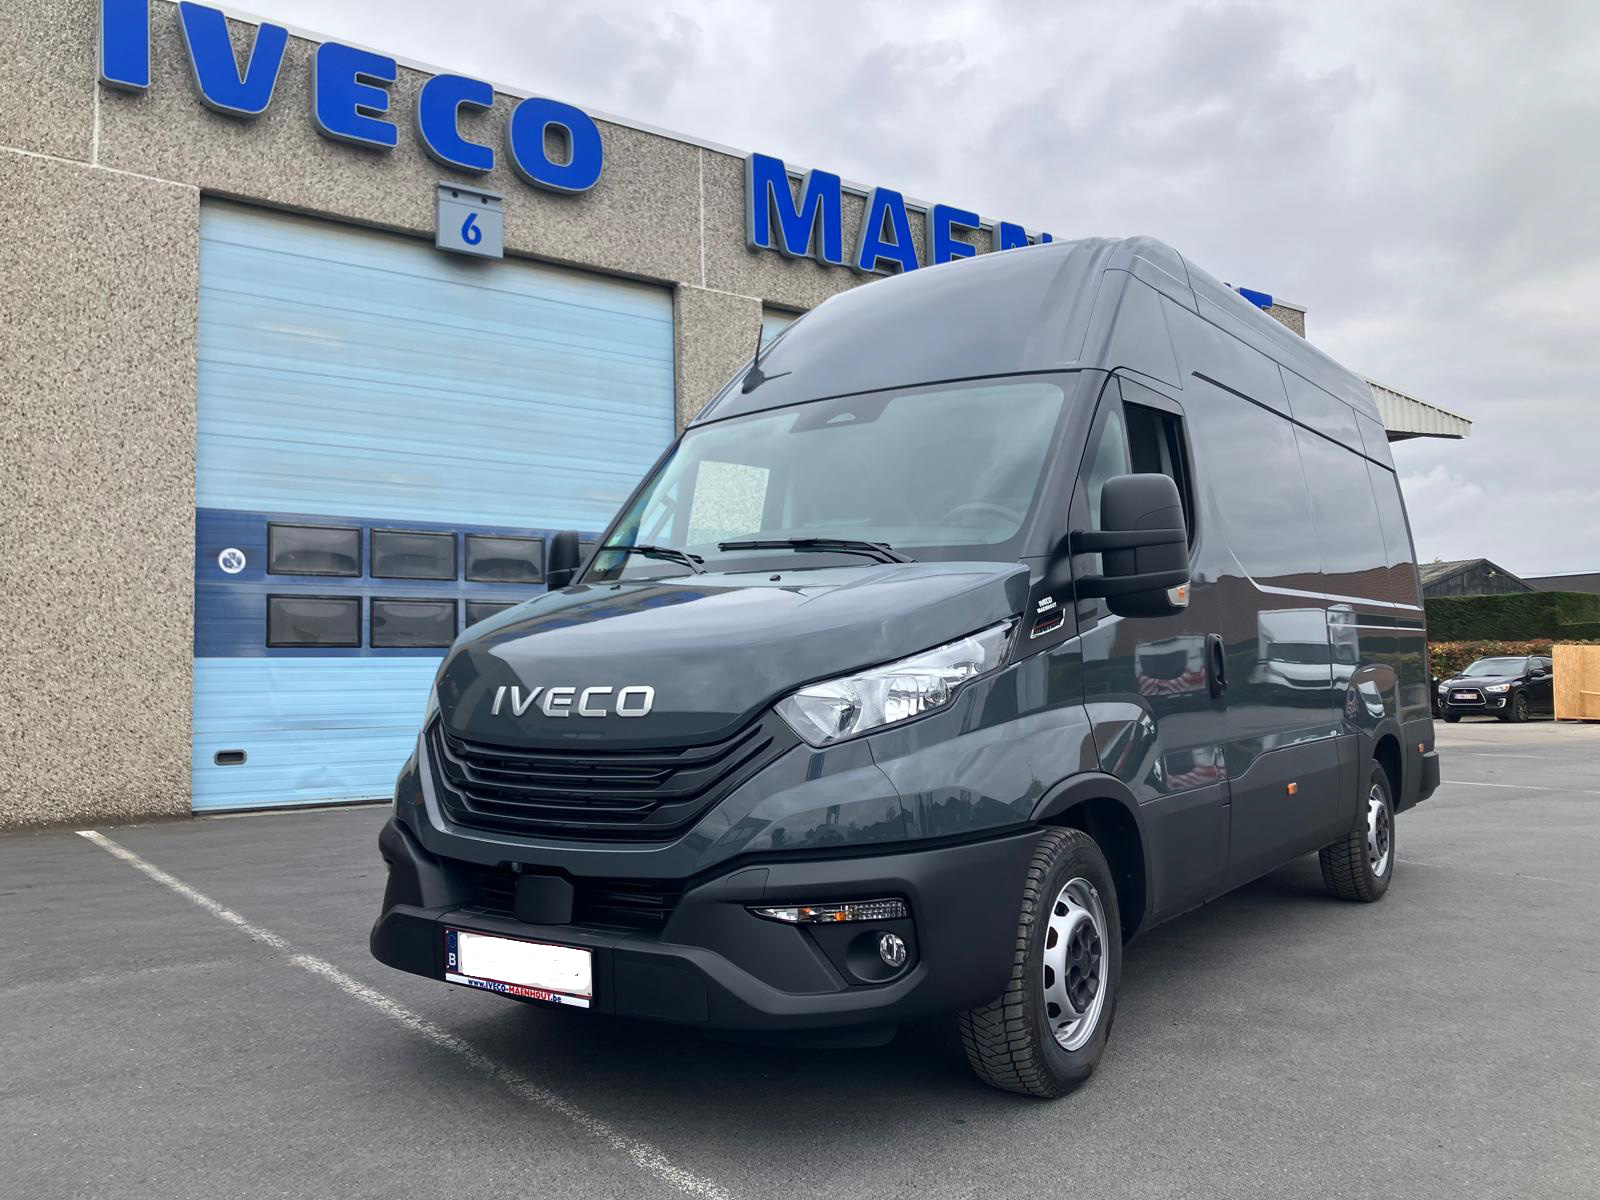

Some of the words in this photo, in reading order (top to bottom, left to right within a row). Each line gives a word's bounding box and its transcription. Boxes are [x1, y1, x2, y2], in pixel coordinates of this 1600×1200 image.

[100, 0, 604, 193] IVECO
[461, 212, 482, 246] 6
[491, 685, 656, 718] IVECO
[448, 953, 457, 966] B
[467, 978, 562, 1003] www.IVECO-MAENHOUT.be
